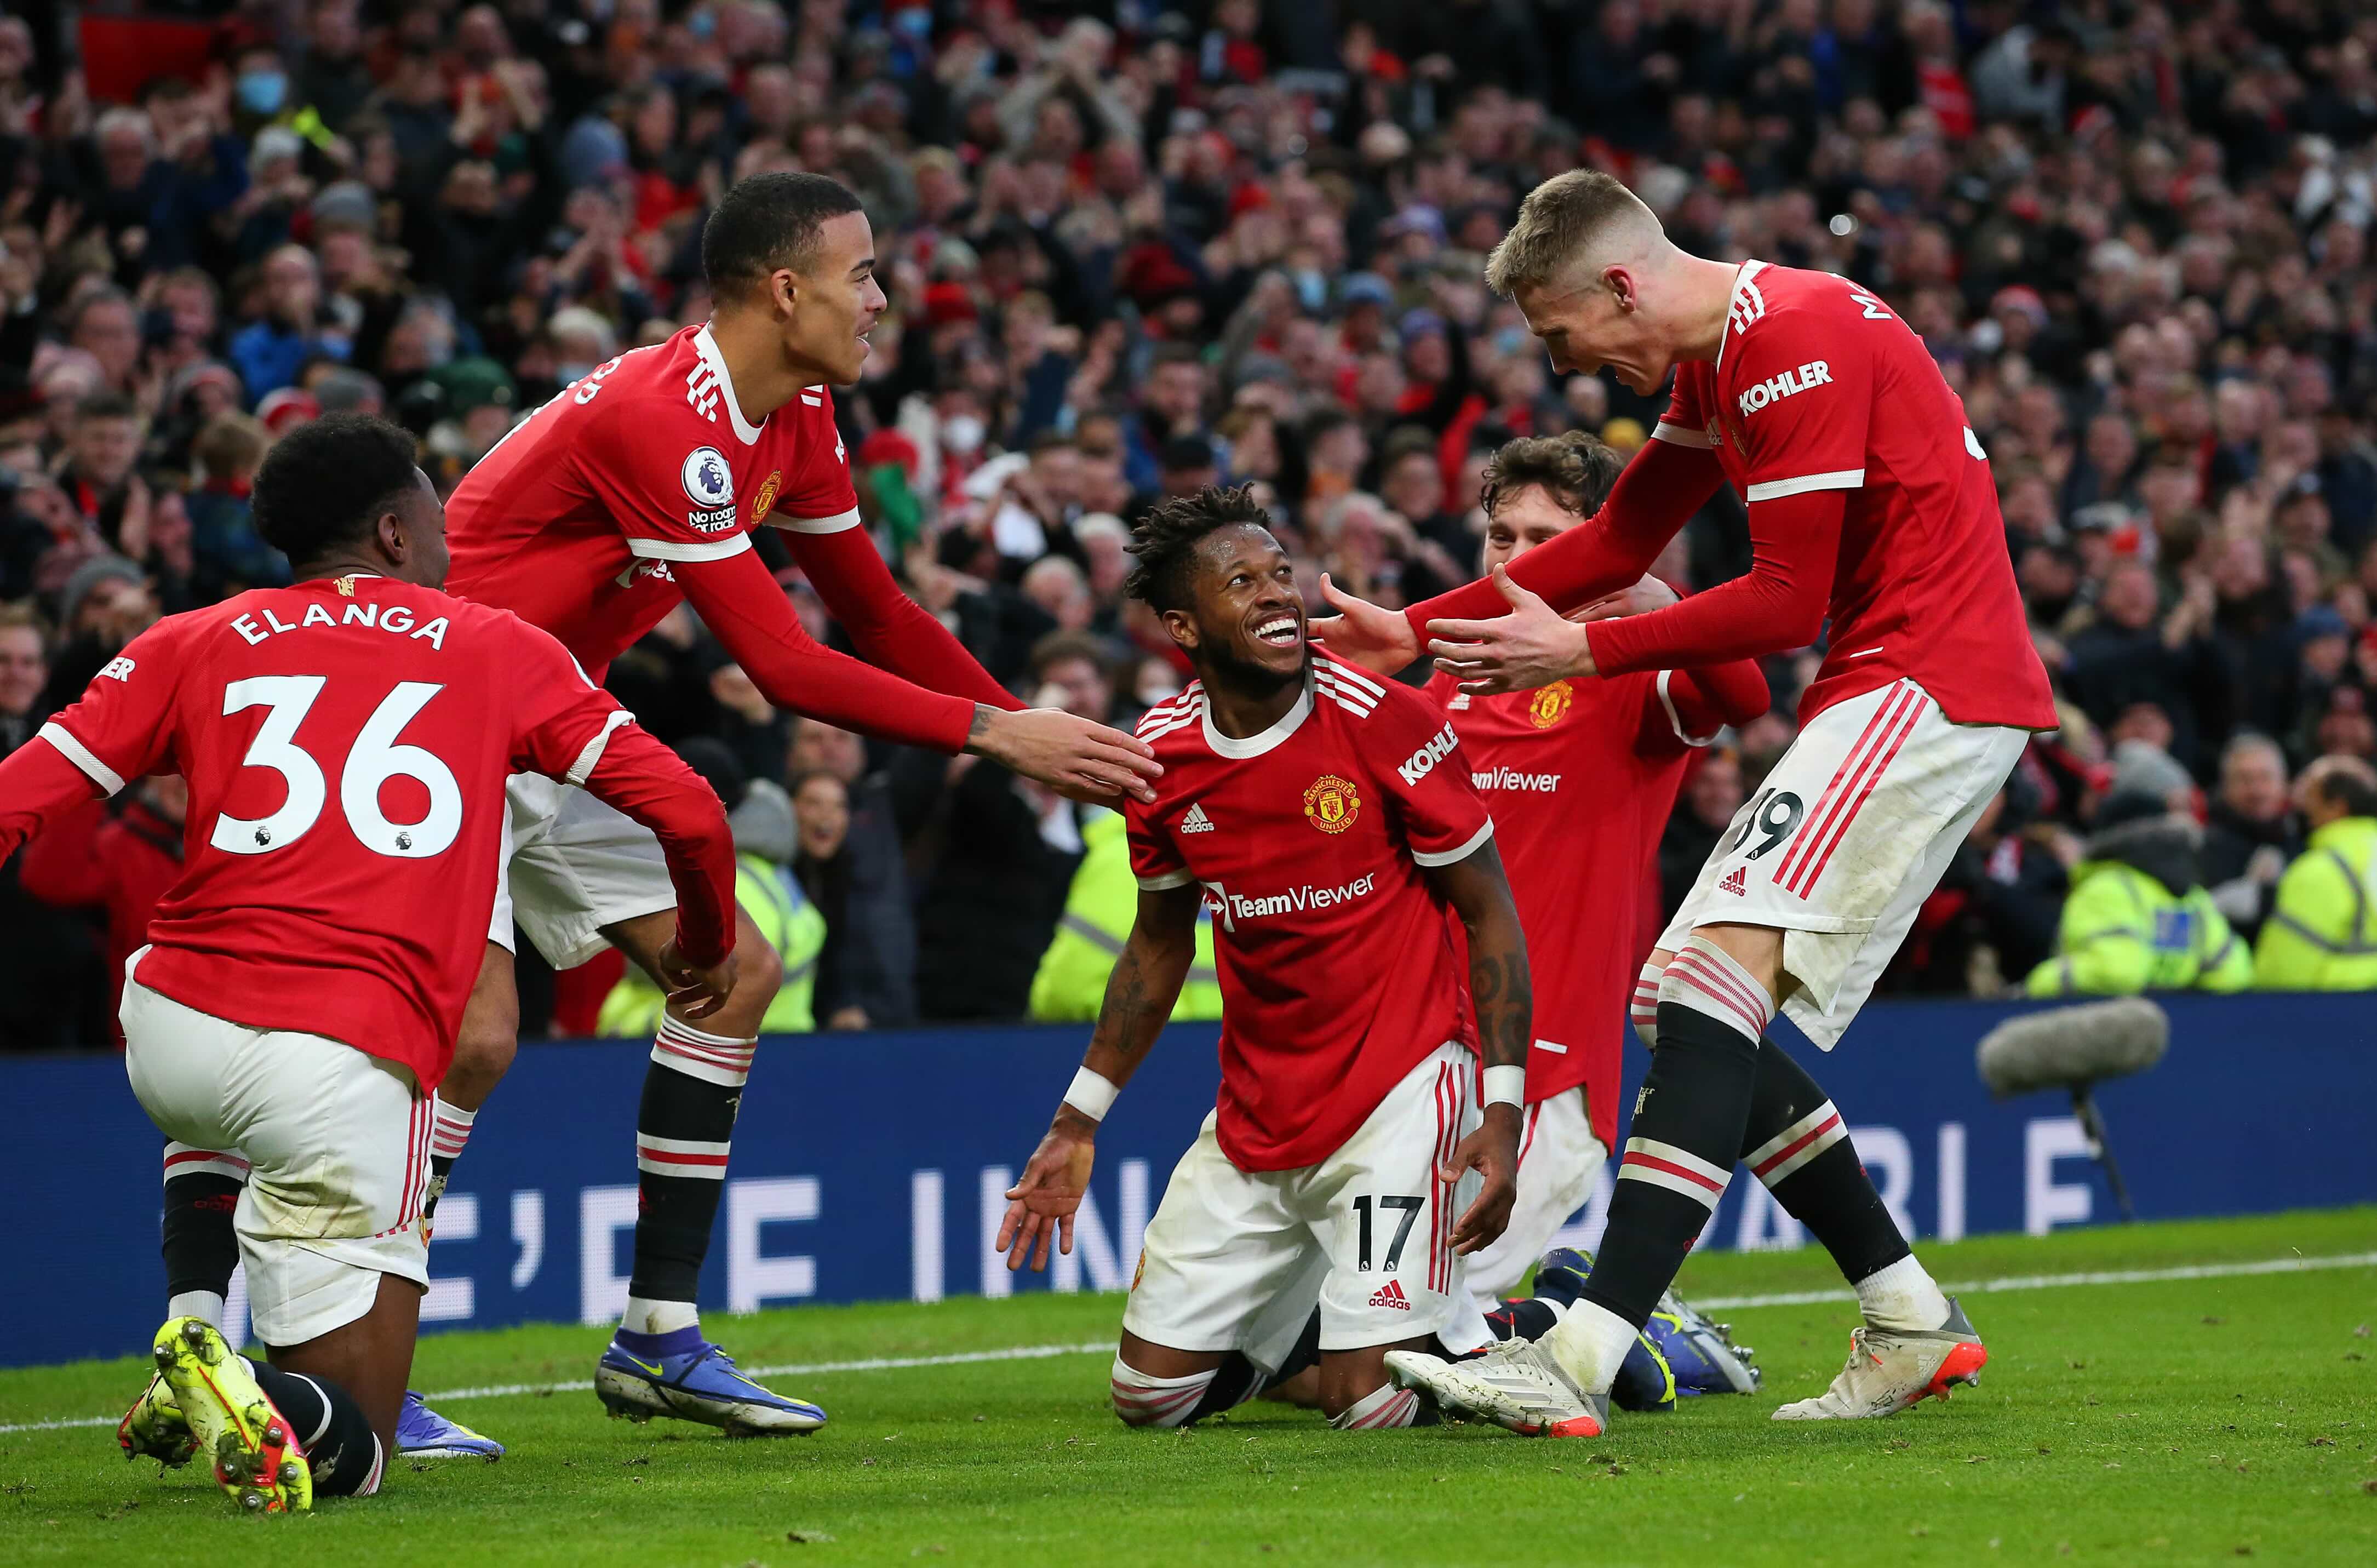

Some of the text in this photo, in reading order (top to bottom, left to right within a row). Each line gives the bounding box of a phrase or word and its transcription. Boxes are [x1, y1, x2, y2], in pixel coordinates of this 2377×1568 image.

[1739, 360, 1834, 417] KOHLER
[689, 506, 736, 524] No room
[230, 602, 449, 651] ELANGA
[210, 674, 463, 859] 36
[1397, 720, 1459, 787] KOHLE
[1308, 779, 1353, 801] MANCHESTER
[1472, 766, 1561, 792] amViewer
[1181, 821, 1215, 834] adidas
[1319, 817, 1351, 829] UNITED
[1228, 872, 1374, 919] TeamViewer
[1719, 880, 1746, 897] adidas
[1352, 1194, 1426, 1272] 17
[1368, 1295, 1411, 1311] adidas
